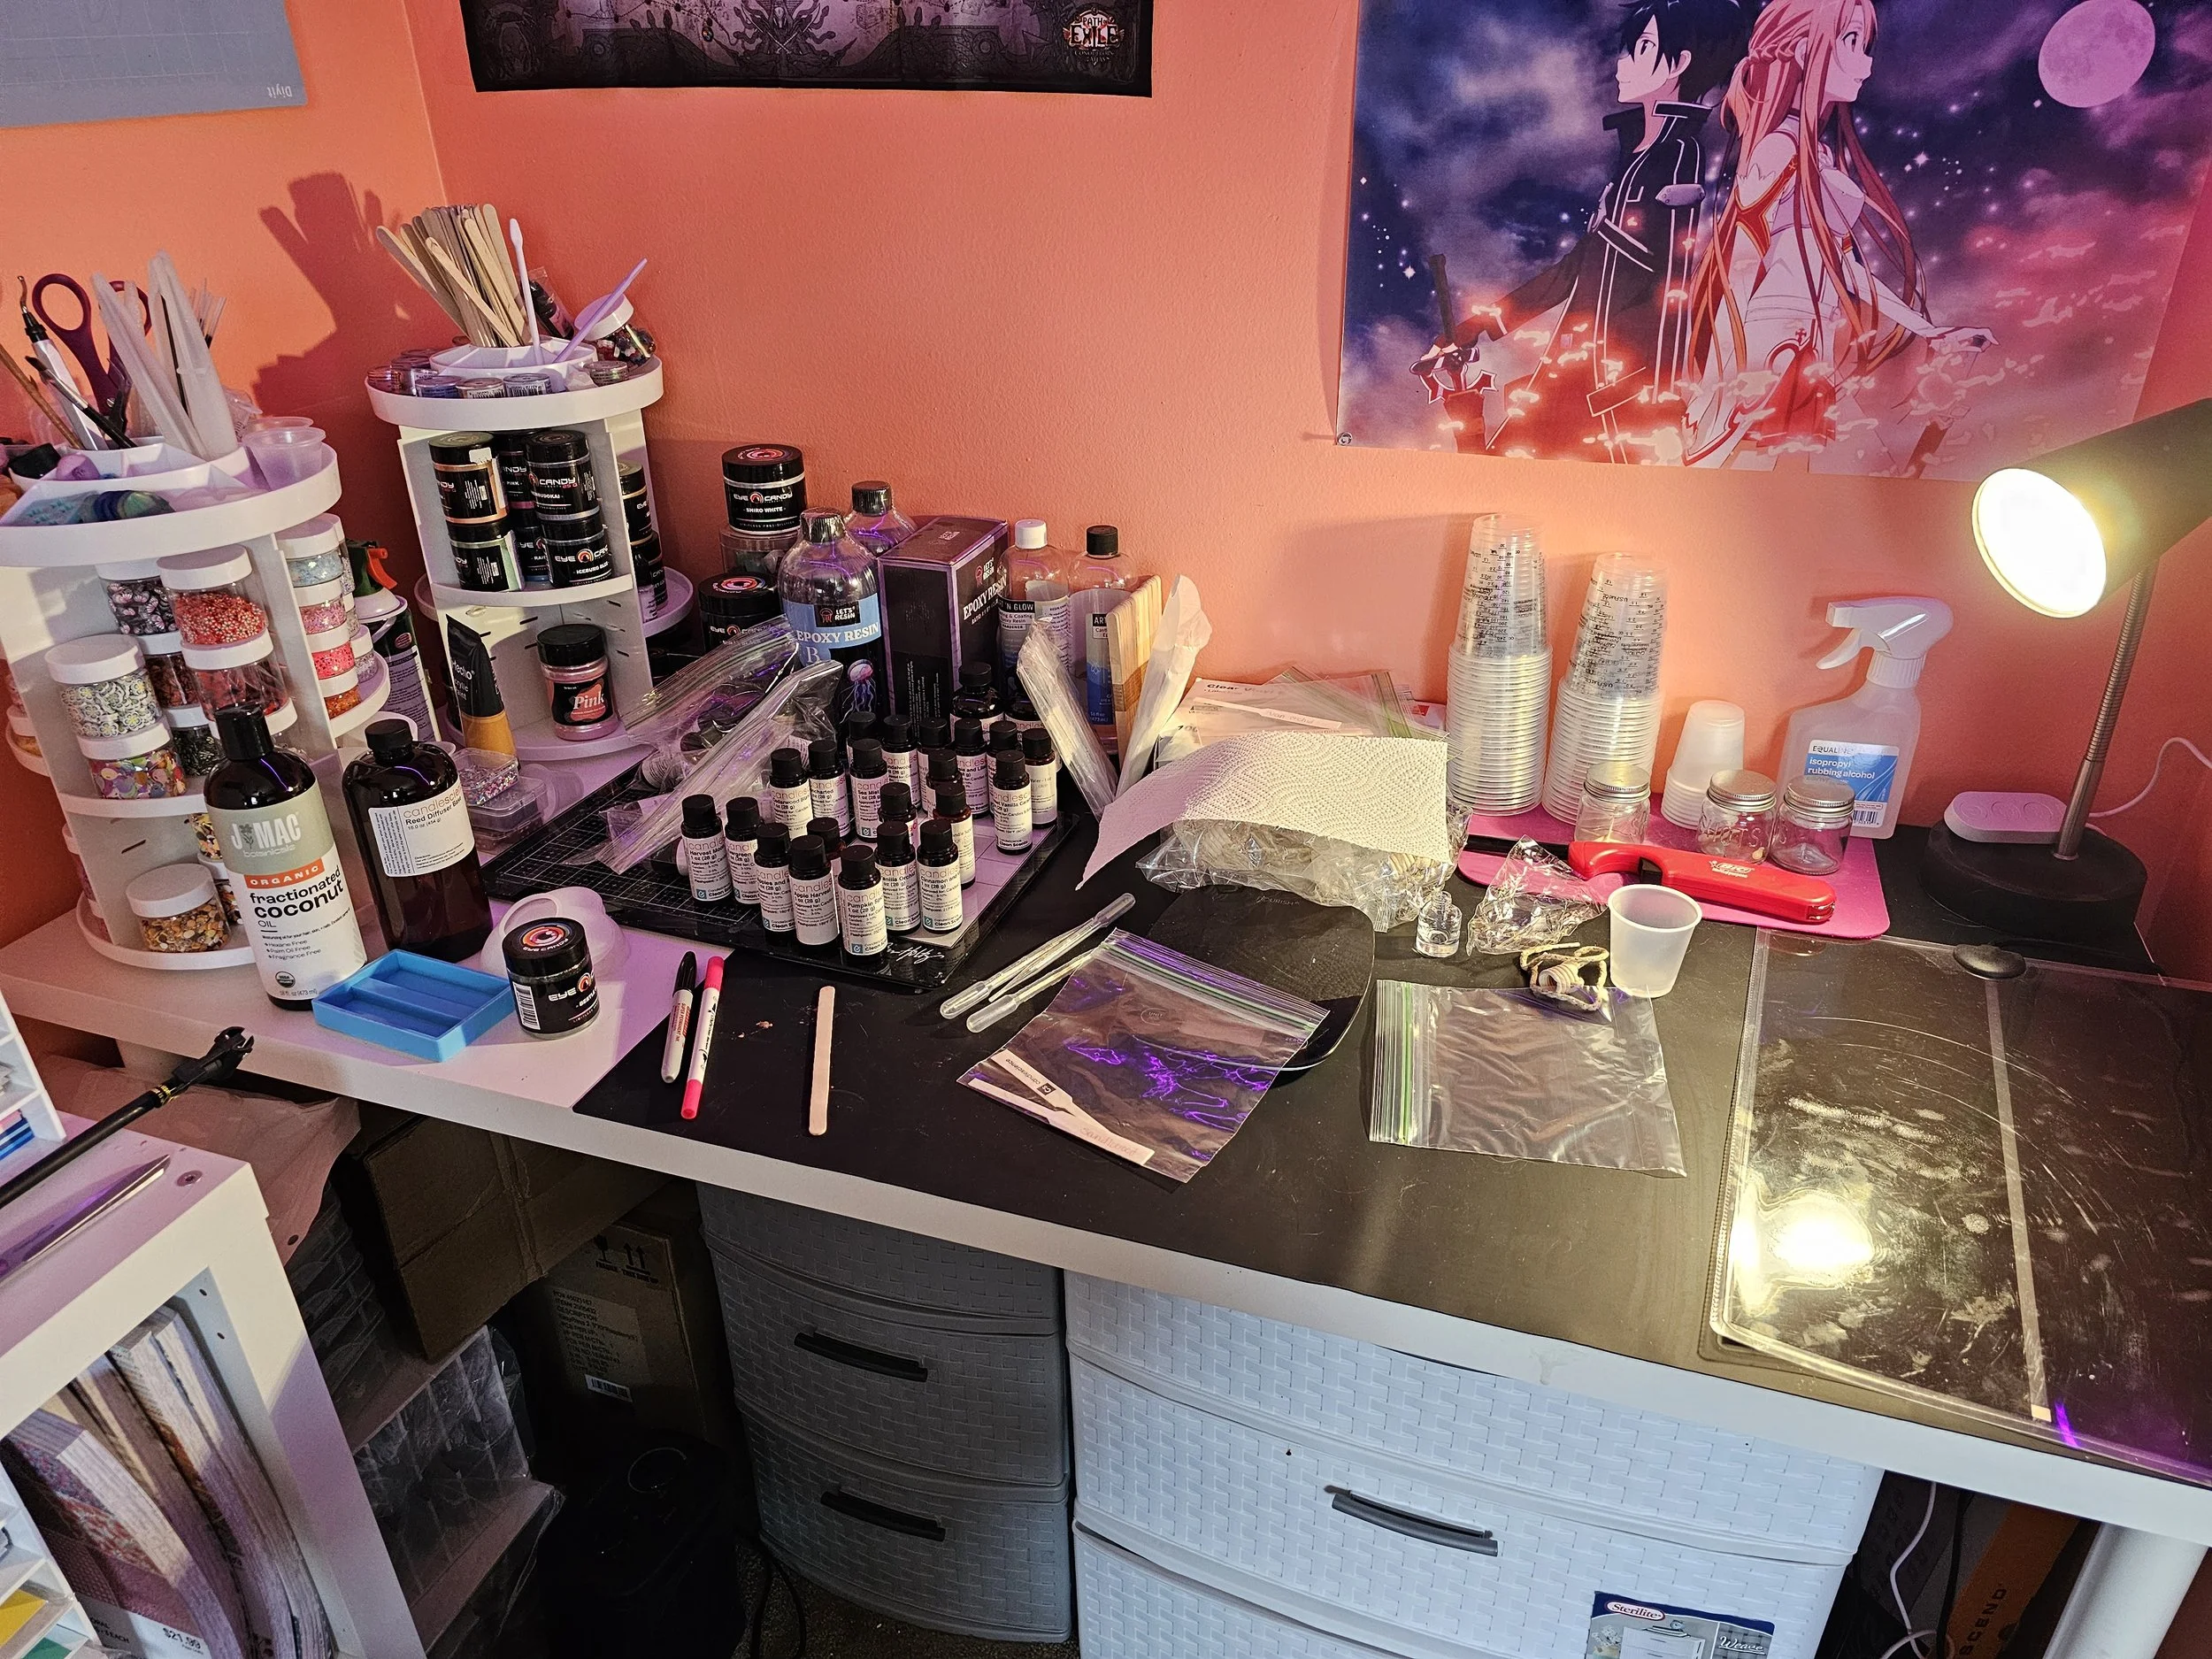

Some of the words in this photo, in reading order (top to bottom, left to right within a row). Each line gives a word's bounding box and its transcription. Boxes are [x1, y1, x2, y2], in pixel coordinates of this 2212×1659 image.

[1083, 17, 1102, 26] PATH
[1071, 25, 1118, 47] EXILE
[764, 489, 793, 502] CANDY
[963, 590, 987, 620] EPOXY
[987, 573, 1007, 601] RESIN
[834, 612, 856, 621] RESIN
[1094, 616, 1106, 625] AR
[796, 630, 841, 643] EPOXY
[843, 622, 879, 642] RESIN
[806, 646, 822, 664] B
[573, 693, 605, 710] Pink
[1809, 757, 1852, 768] isopropyl
[1807, 767, 1842, 779] rubbing
[1843, 770, 1876, 780] alcohol
[405, 815, 426, 826] Reed
[426, 804, 453, 820] Diffuser
[242, 844, 296, 858] botanicals
[250, 865, 319, 886] ORGANIC
[1717, 862, 1753, 874] BIC
[899, 872, 916, 881] Orchid
[250, 865, 342, 904] fractionated
[254, 879, 344, 918] coconut
[811, 887, 832, 899] Harvest
[847, 901, 873, 910] Pumpkin
[541, 938, 569, 952] CANDY
[549, 987, 577, 1002] EYE
[1005, 1058, 1041, 1086] candlescience
[1613, 1602, 1658, 1619] Sterilite
[1718, 1636, 1764, 1653] Weave
